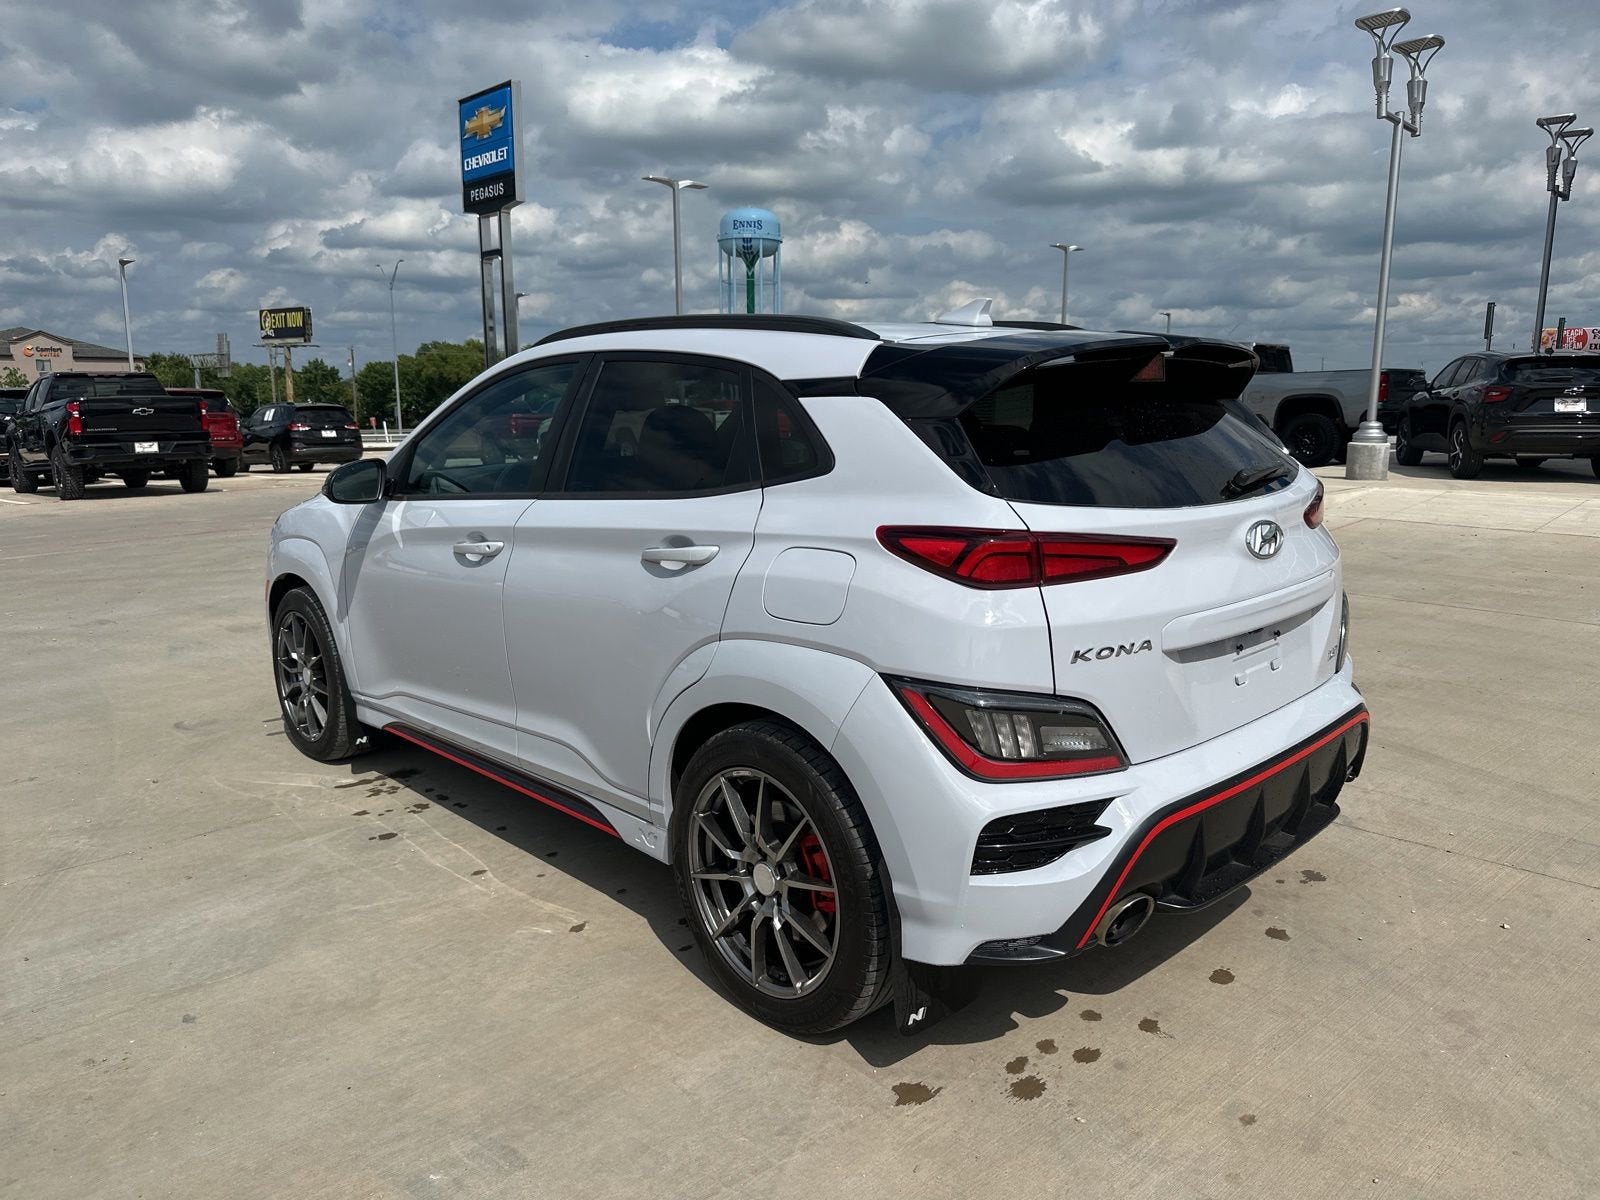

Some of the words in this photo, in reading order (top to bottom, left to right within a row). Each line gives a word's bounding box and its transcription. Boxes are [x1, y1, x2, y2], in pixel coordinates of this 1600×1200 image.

[464, 146, 508, 171] CHEVROLET
[470, 182, 504, 201] PEGASUS
[733, 219, 763, 231] ENNIS
[271, 312, 285, 329] EXIT
[286, 311, 303, 328] NOW
[1070, 639, 1152, 664] KONA
